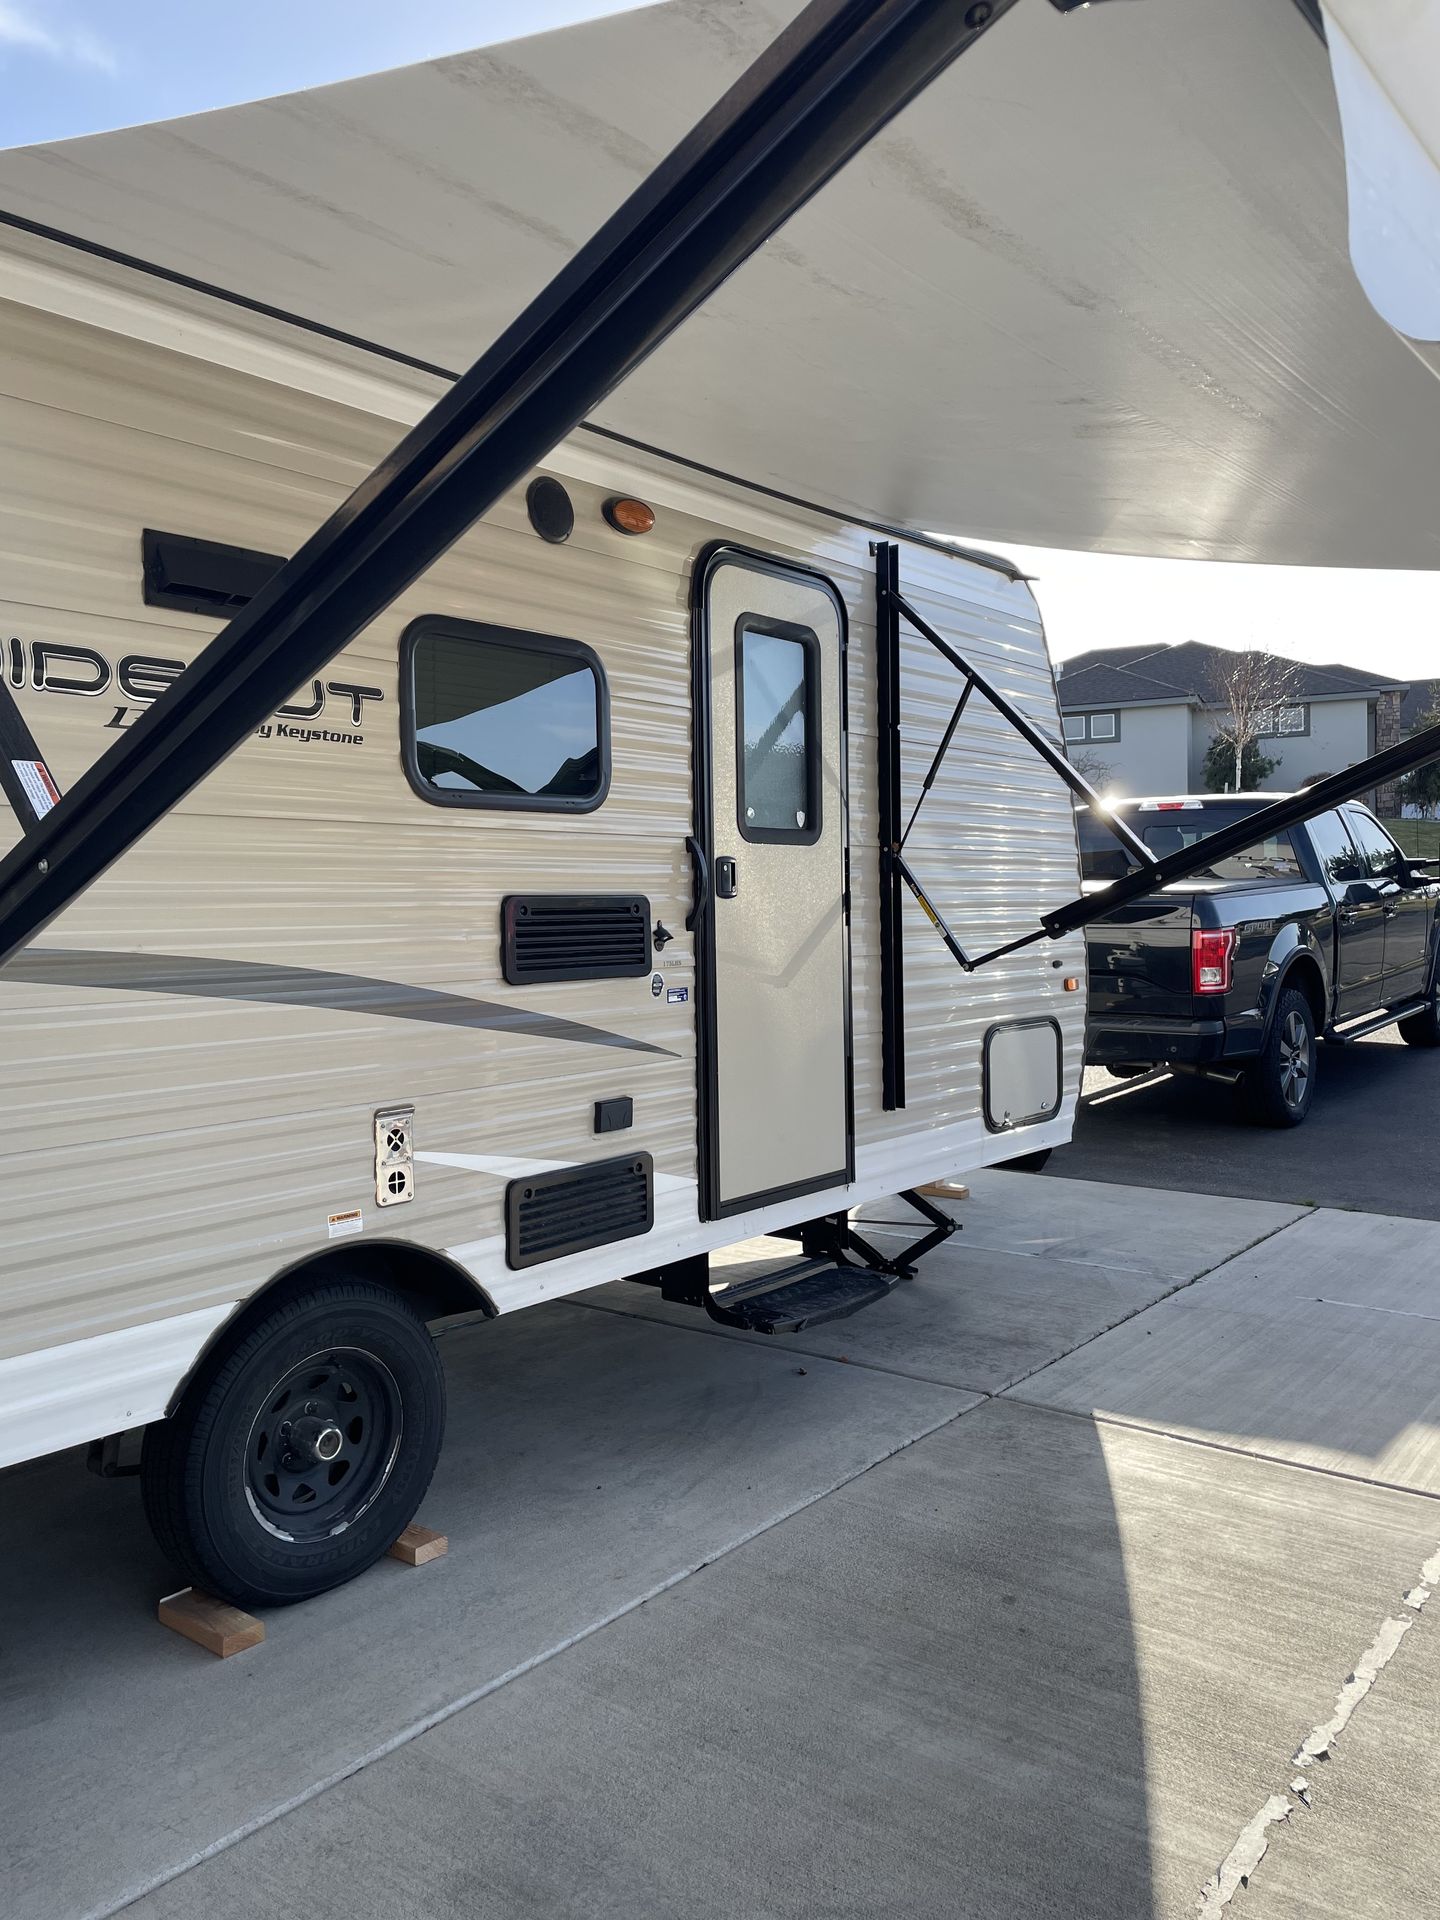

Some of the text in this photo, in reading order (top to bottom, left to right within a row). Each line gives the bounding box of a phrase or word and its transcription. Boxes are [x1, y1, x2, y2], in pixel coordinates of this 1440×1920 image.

[0, 636, 384, 727] IDEUT
[254, 723, 364, 745] y Keystone
[1241, 919, 1276, 936] SPORT
